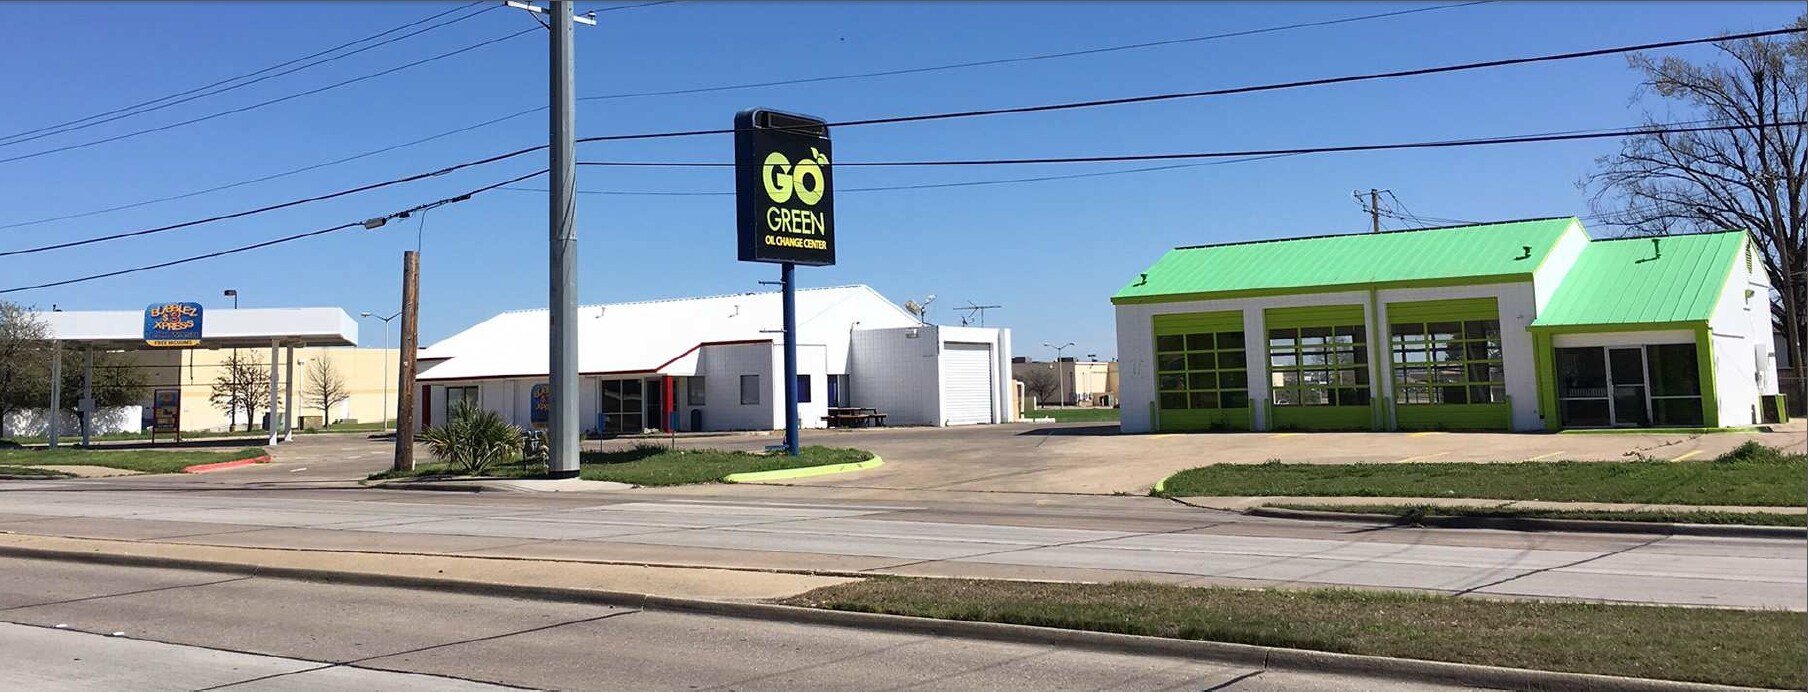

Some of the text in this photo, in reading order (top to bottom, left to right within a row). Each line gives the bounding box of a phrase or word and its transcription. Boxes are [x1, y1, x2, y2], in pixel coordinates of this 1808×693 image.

[763, 152, 825, 206] GO
[767, 206, 825, 236] GREEN
[765, 235, 827, 250] OIL CHANGE CENTER
[151, 304, 198, 317] BUBBLEZ
[154, 320, 194, 330] XPRESS
